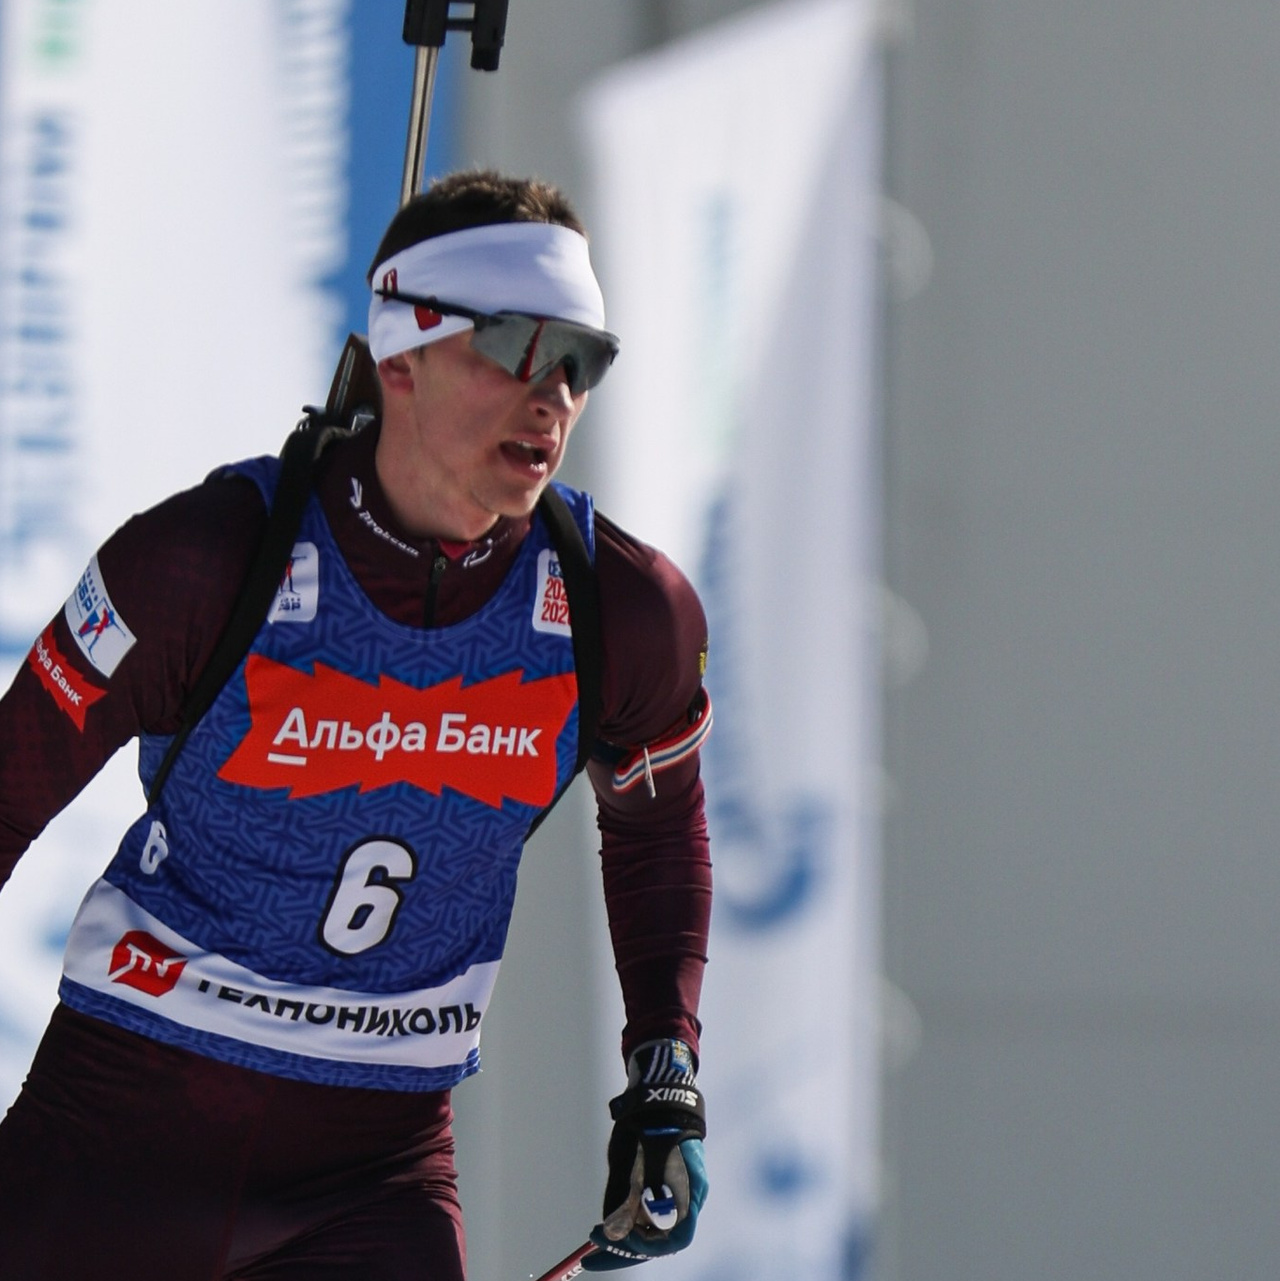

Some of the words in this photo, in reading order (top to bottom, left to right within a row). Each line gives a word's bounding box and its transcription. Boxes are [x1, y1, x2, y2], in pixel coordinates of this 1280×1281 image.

[50, 663, 84, 706] Банк
[270, 707, 427, 762] Альфа
[436, 713, 542, 757] Банк
[139, 820, 169, 875] 6
[321, 837, 416, 957] 6
[645, 1087, 698, 1107] SWIX
